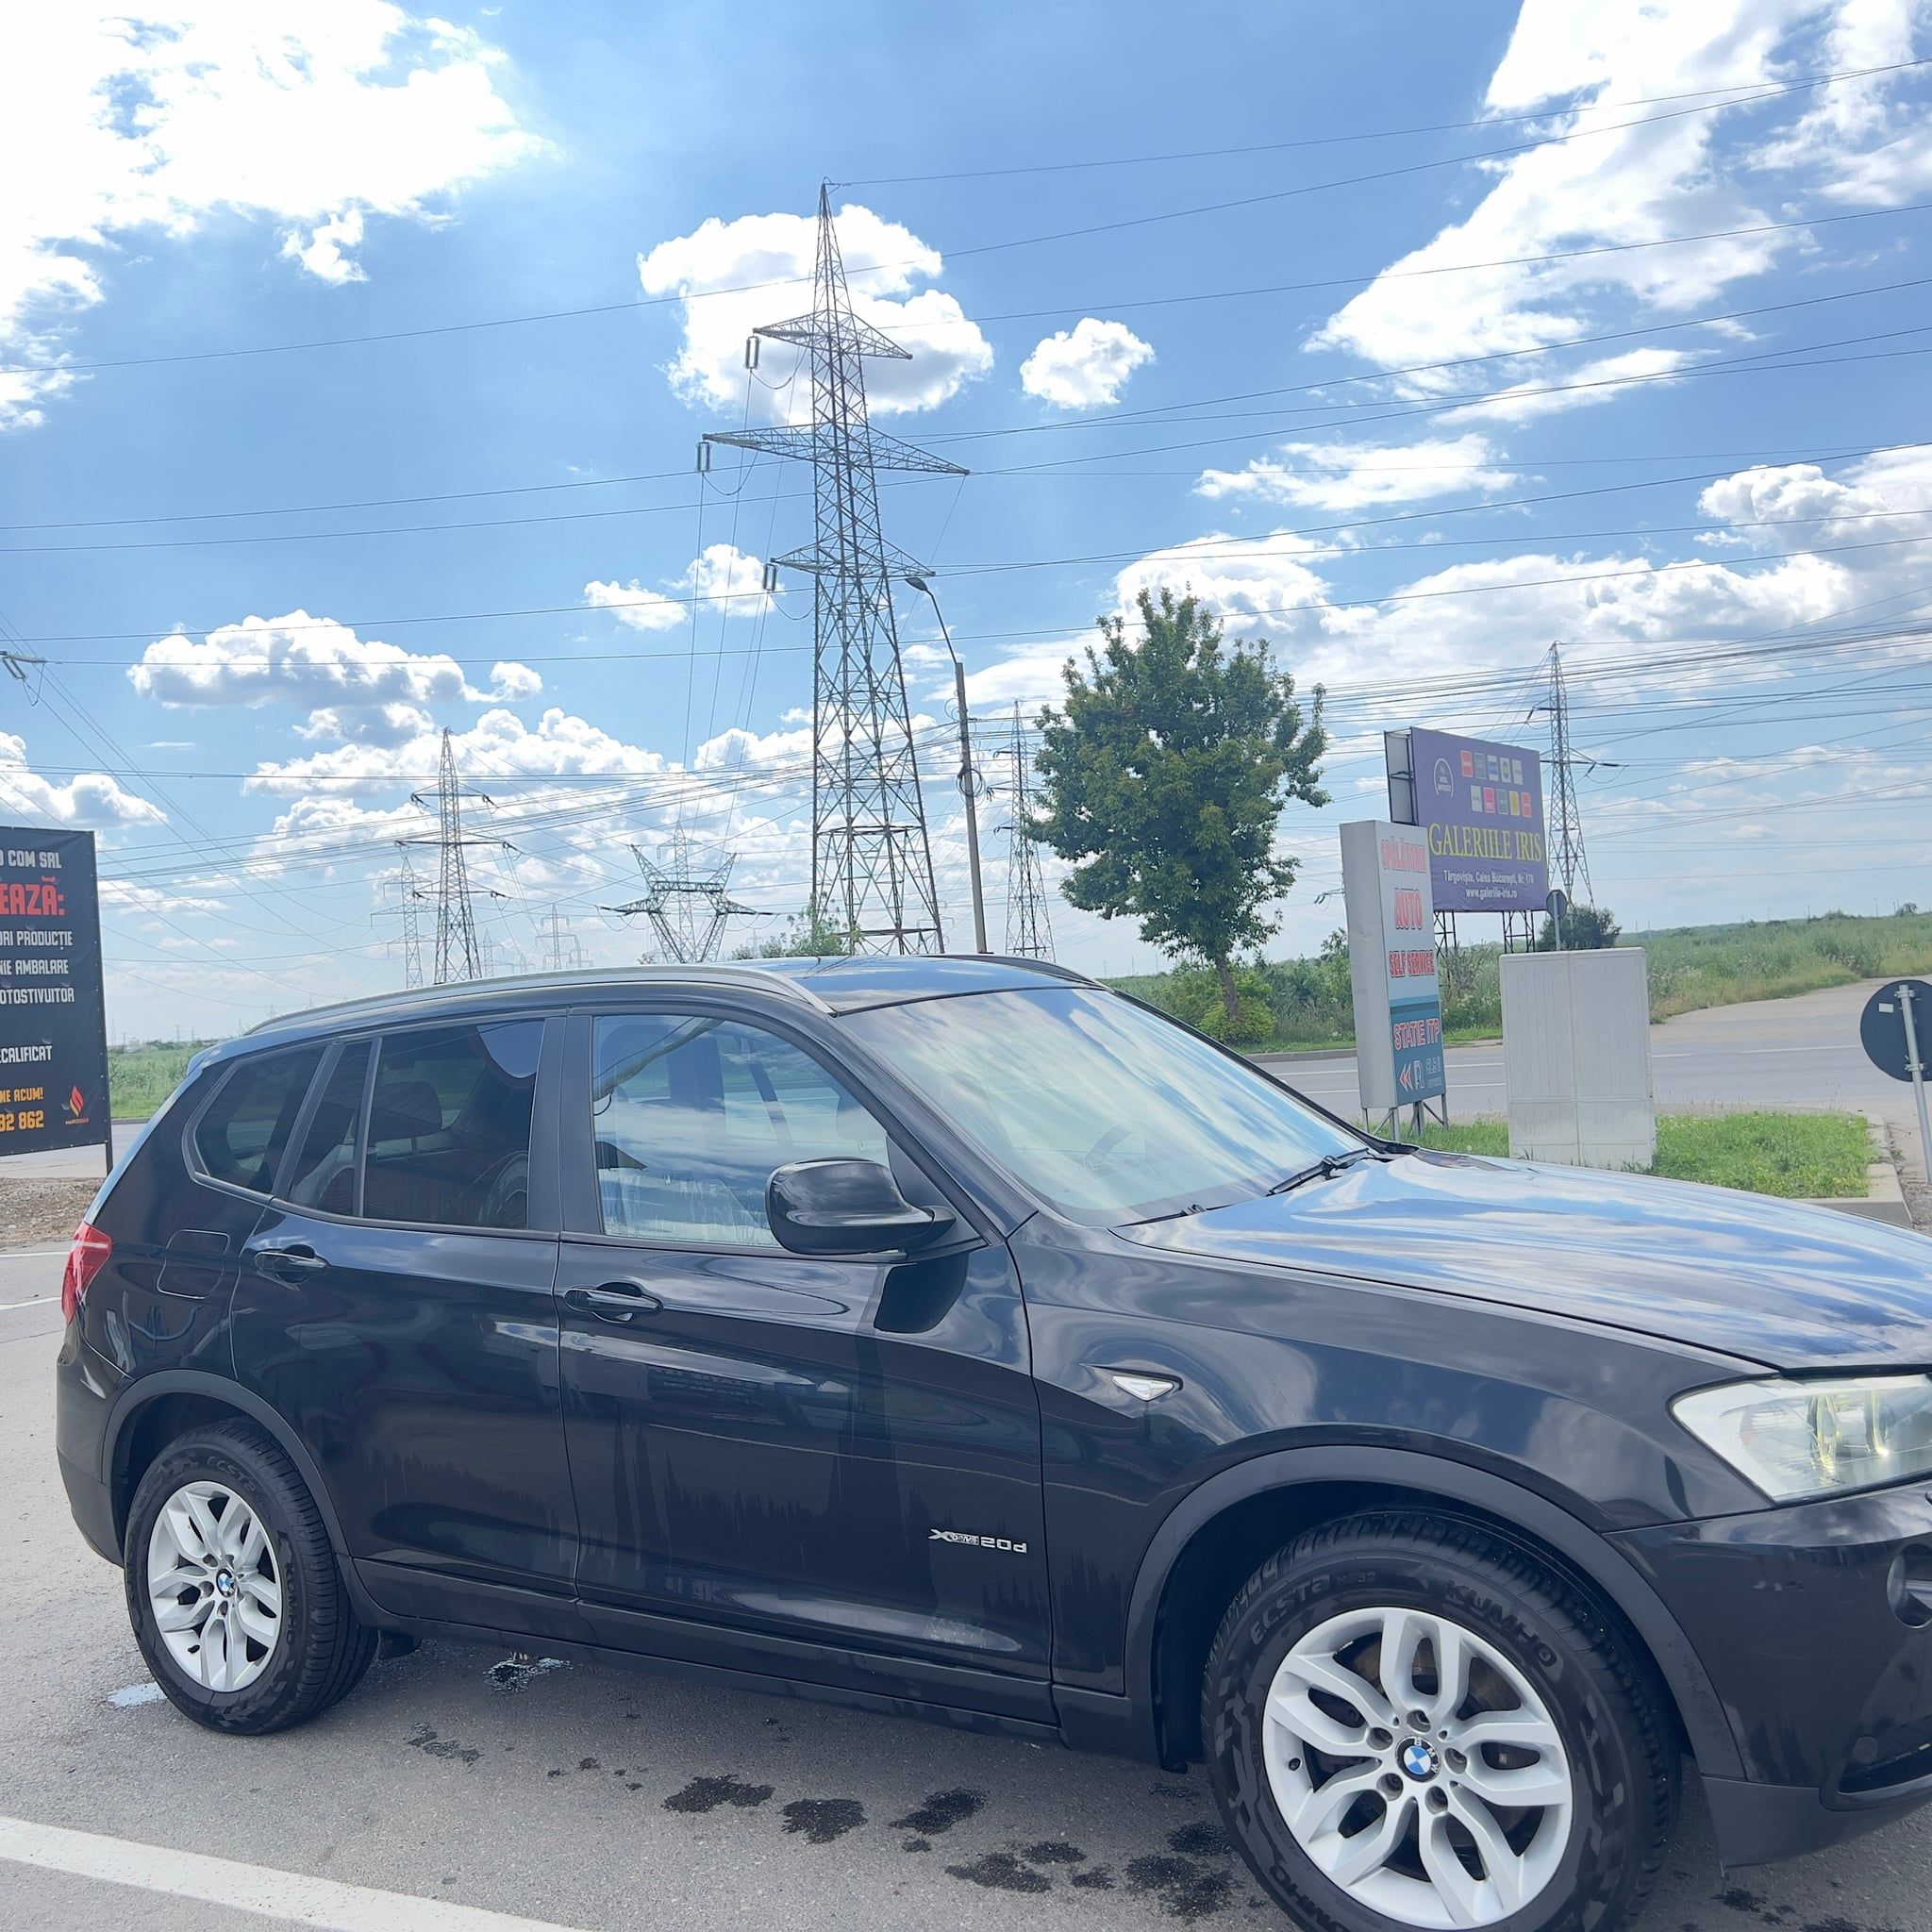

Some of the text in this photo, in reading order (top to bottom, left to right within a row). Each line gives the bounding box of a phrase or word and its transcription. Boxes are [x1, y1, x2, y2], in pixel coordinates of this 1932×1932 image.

[1427, 823, 1542, 862] GALERIILE IRIS
[8, 849, 36, 868] COM
[39, 851, 62, 869] SRL
[1393, 887, 1423, 930] AUTO
[15, 958, 70, 975] AMBALARE
[1388, 949, 1435, 978] SELF SERVICE
[0, 1045, 53, 1064] CALIFICAT
[13, 1087, 44, 1102] ACUM!
[18, 1109, 44, 1130] 862
[1446, 1578, 1557, 1668] KUMHO
